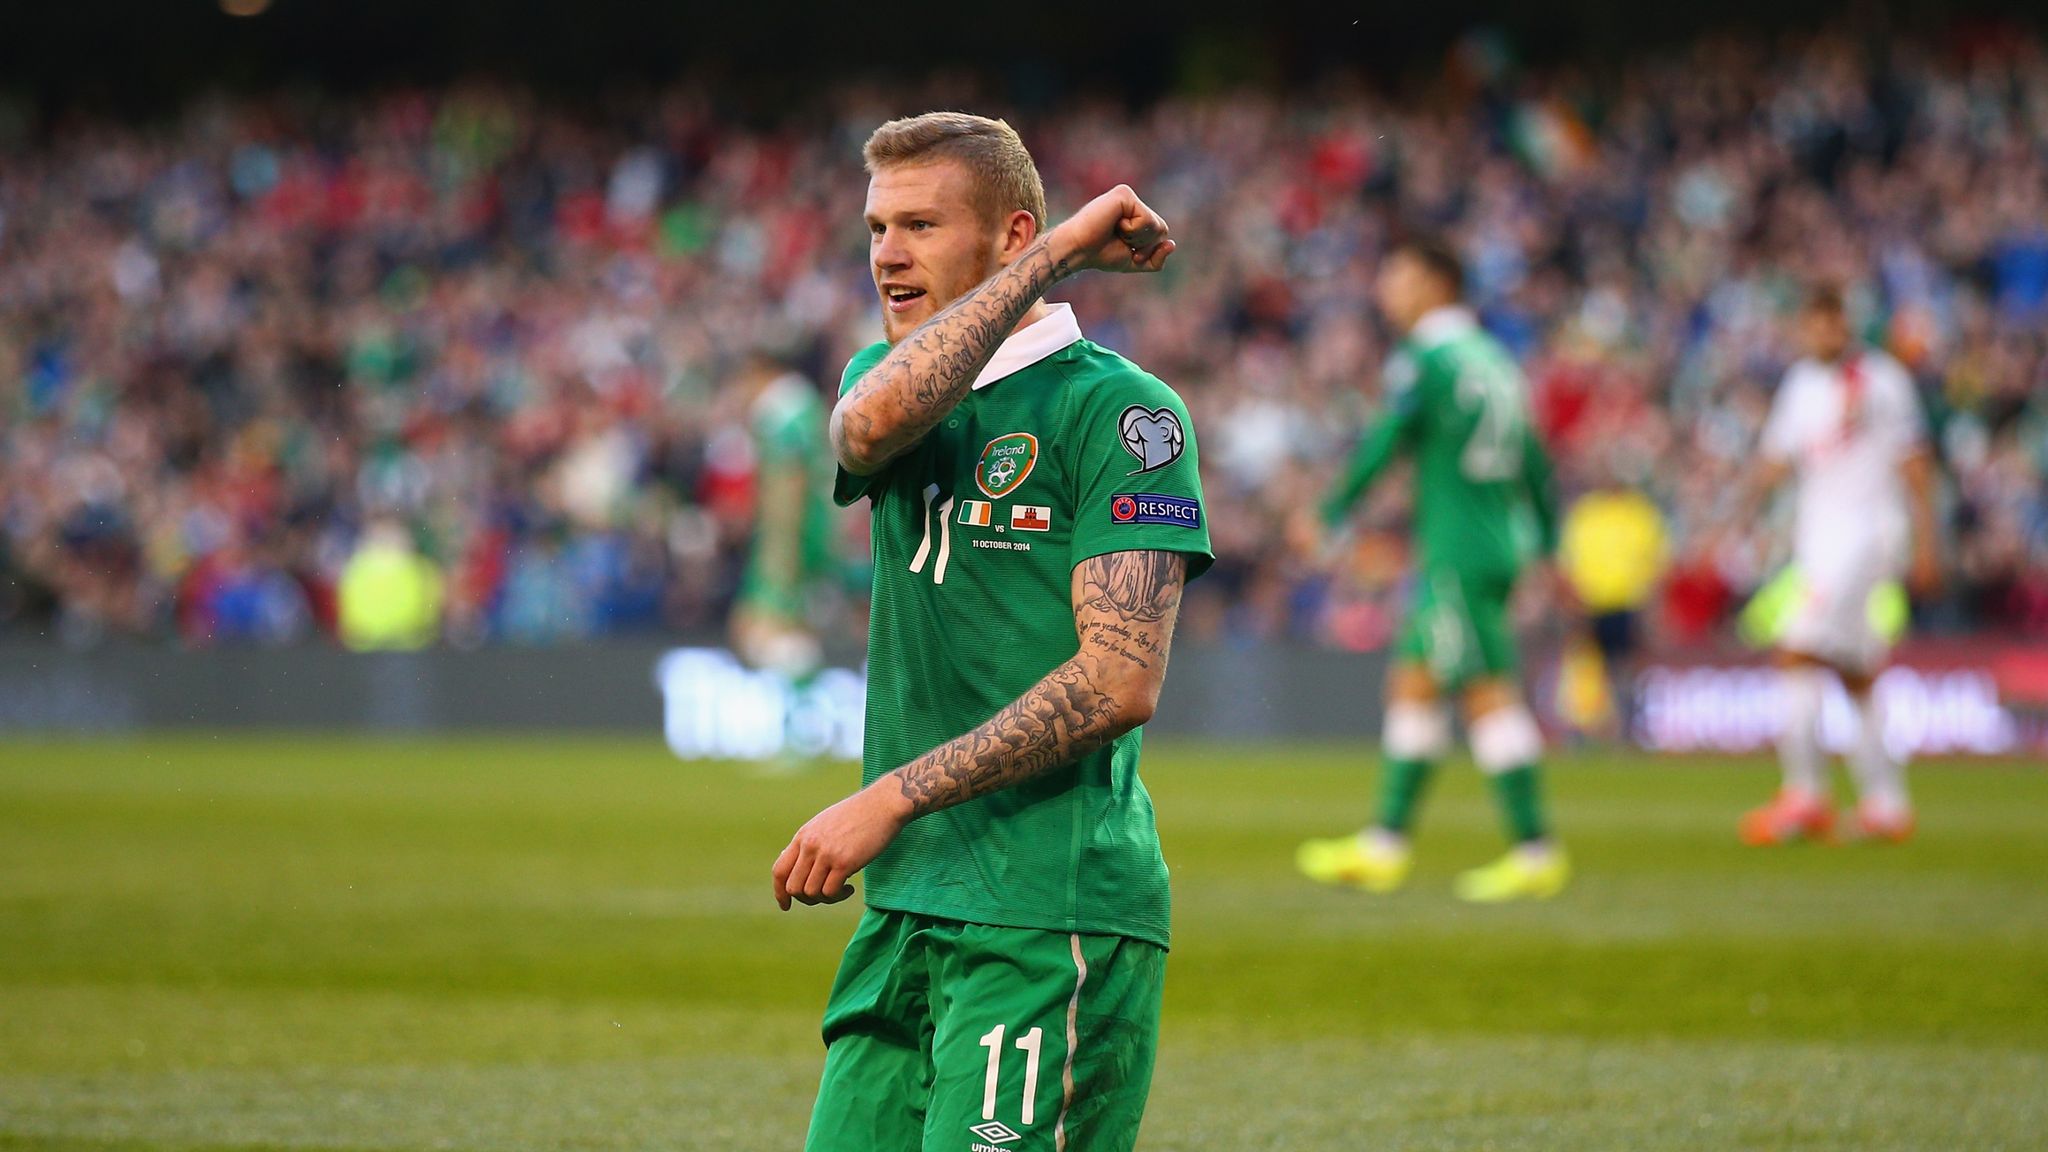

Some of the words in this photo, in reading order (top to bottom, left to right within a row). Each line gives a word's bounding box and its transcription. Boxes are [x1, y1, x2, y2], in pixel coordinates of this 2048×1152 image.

[992, 443, 1026, 456] Ireland
[1139, 502, 1198, 520] RESPECT
[909, 483, 954, 584] 11
[995, 525, 1005, 533] VS
[972, 540, 979, 548] 11
[980, 541, 1012, 550] OCTOBER
[1013, 543, 1030, 551] 2014
[980, 1024, 1042, 1125] 11
[971, 1143, 1012, 1152] umbr
